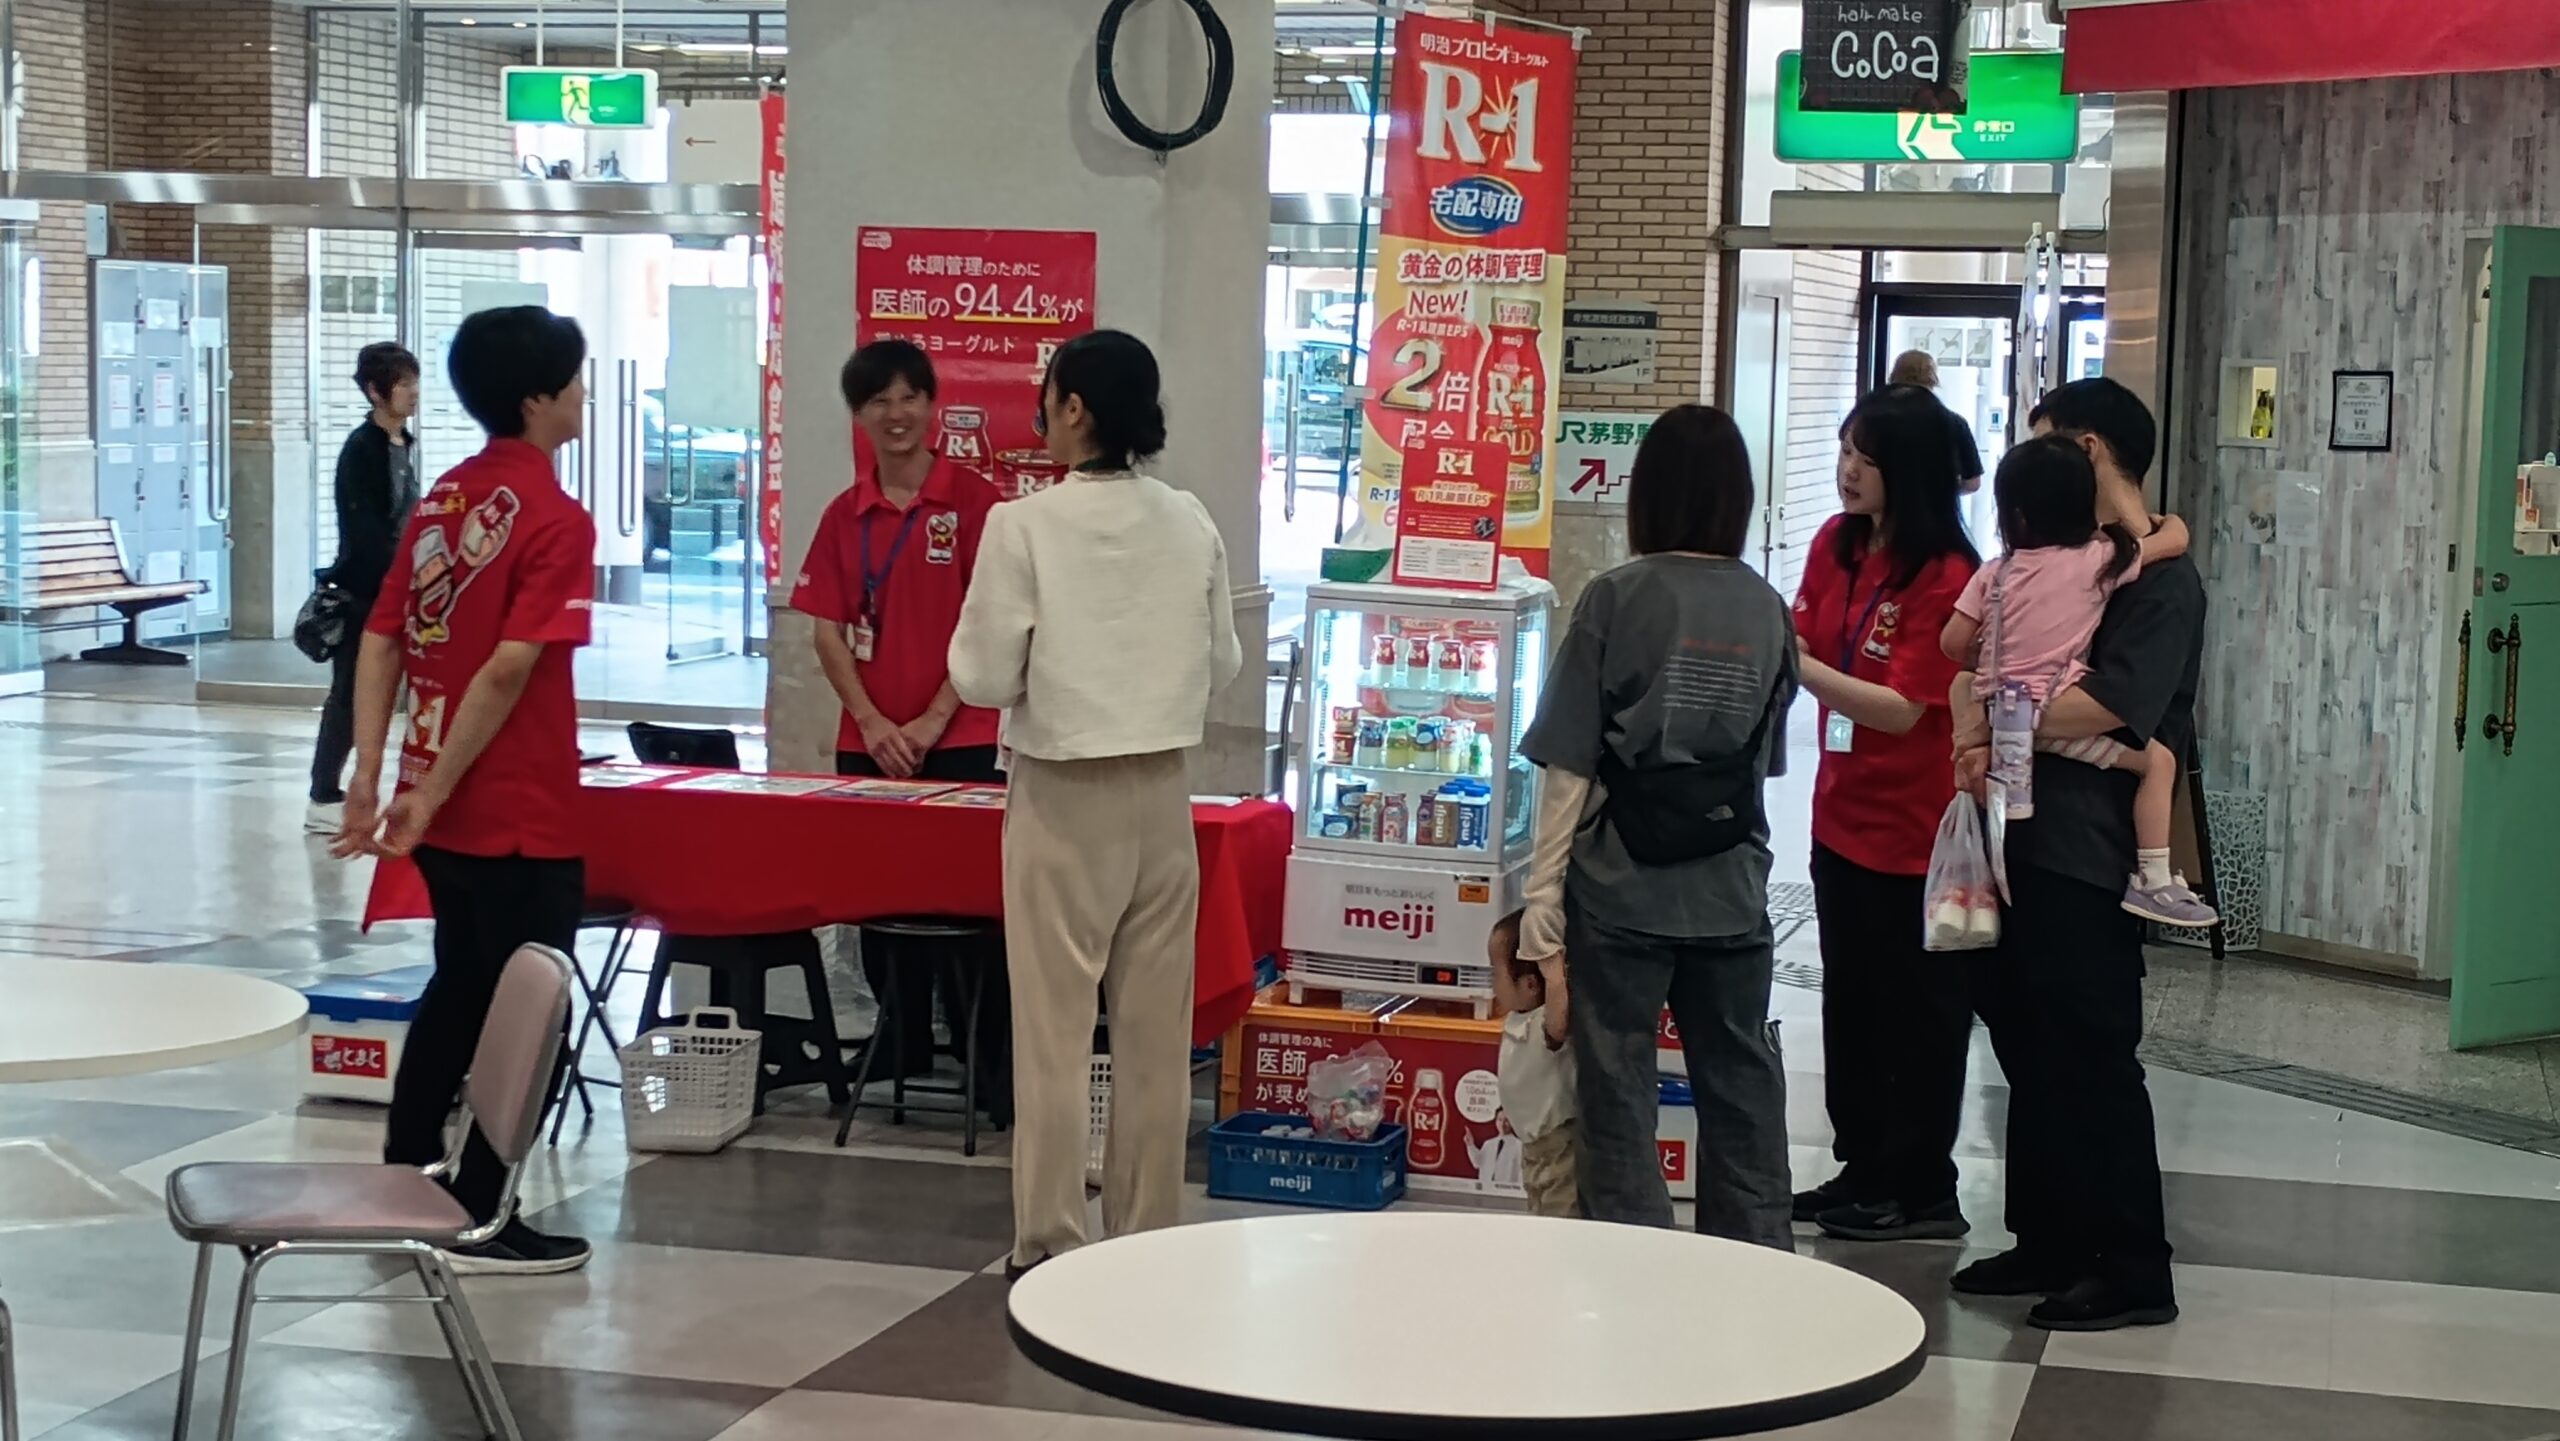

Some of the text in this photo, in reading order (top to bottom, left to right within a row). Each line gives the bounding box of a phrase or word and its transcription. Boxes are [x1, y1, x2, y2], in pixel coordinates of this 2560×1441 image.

[1838, 5, 1924, 23] hair make
[1831, 30, 1940, 83] CoCoa
[1416, 60, 1544, 173] R-1
[1979, 133, 2008, 142] EXIT
[1429, 185, 1524, 223] 宅配専用
[906, 253, 1041, 277] 体調管理のために
[1399, 251, 1544, 281] 黄金の体調管理
[1408, 289, 1469, 316] New!
[1485, 370, 1535, 418] R-1
[945, 434, 982, 458] R-1
[1435, 450, 1475, 476] R-1
[1460, 807, 1474, 841] meiji
[1344, 903, 1434, 940] meiji
[1258, 1032, 1333, 1049] 体調管理の為に
[1414, 1111, 1440, 1131] R-1
[1270, 1174, 1312, 1193] meiji
